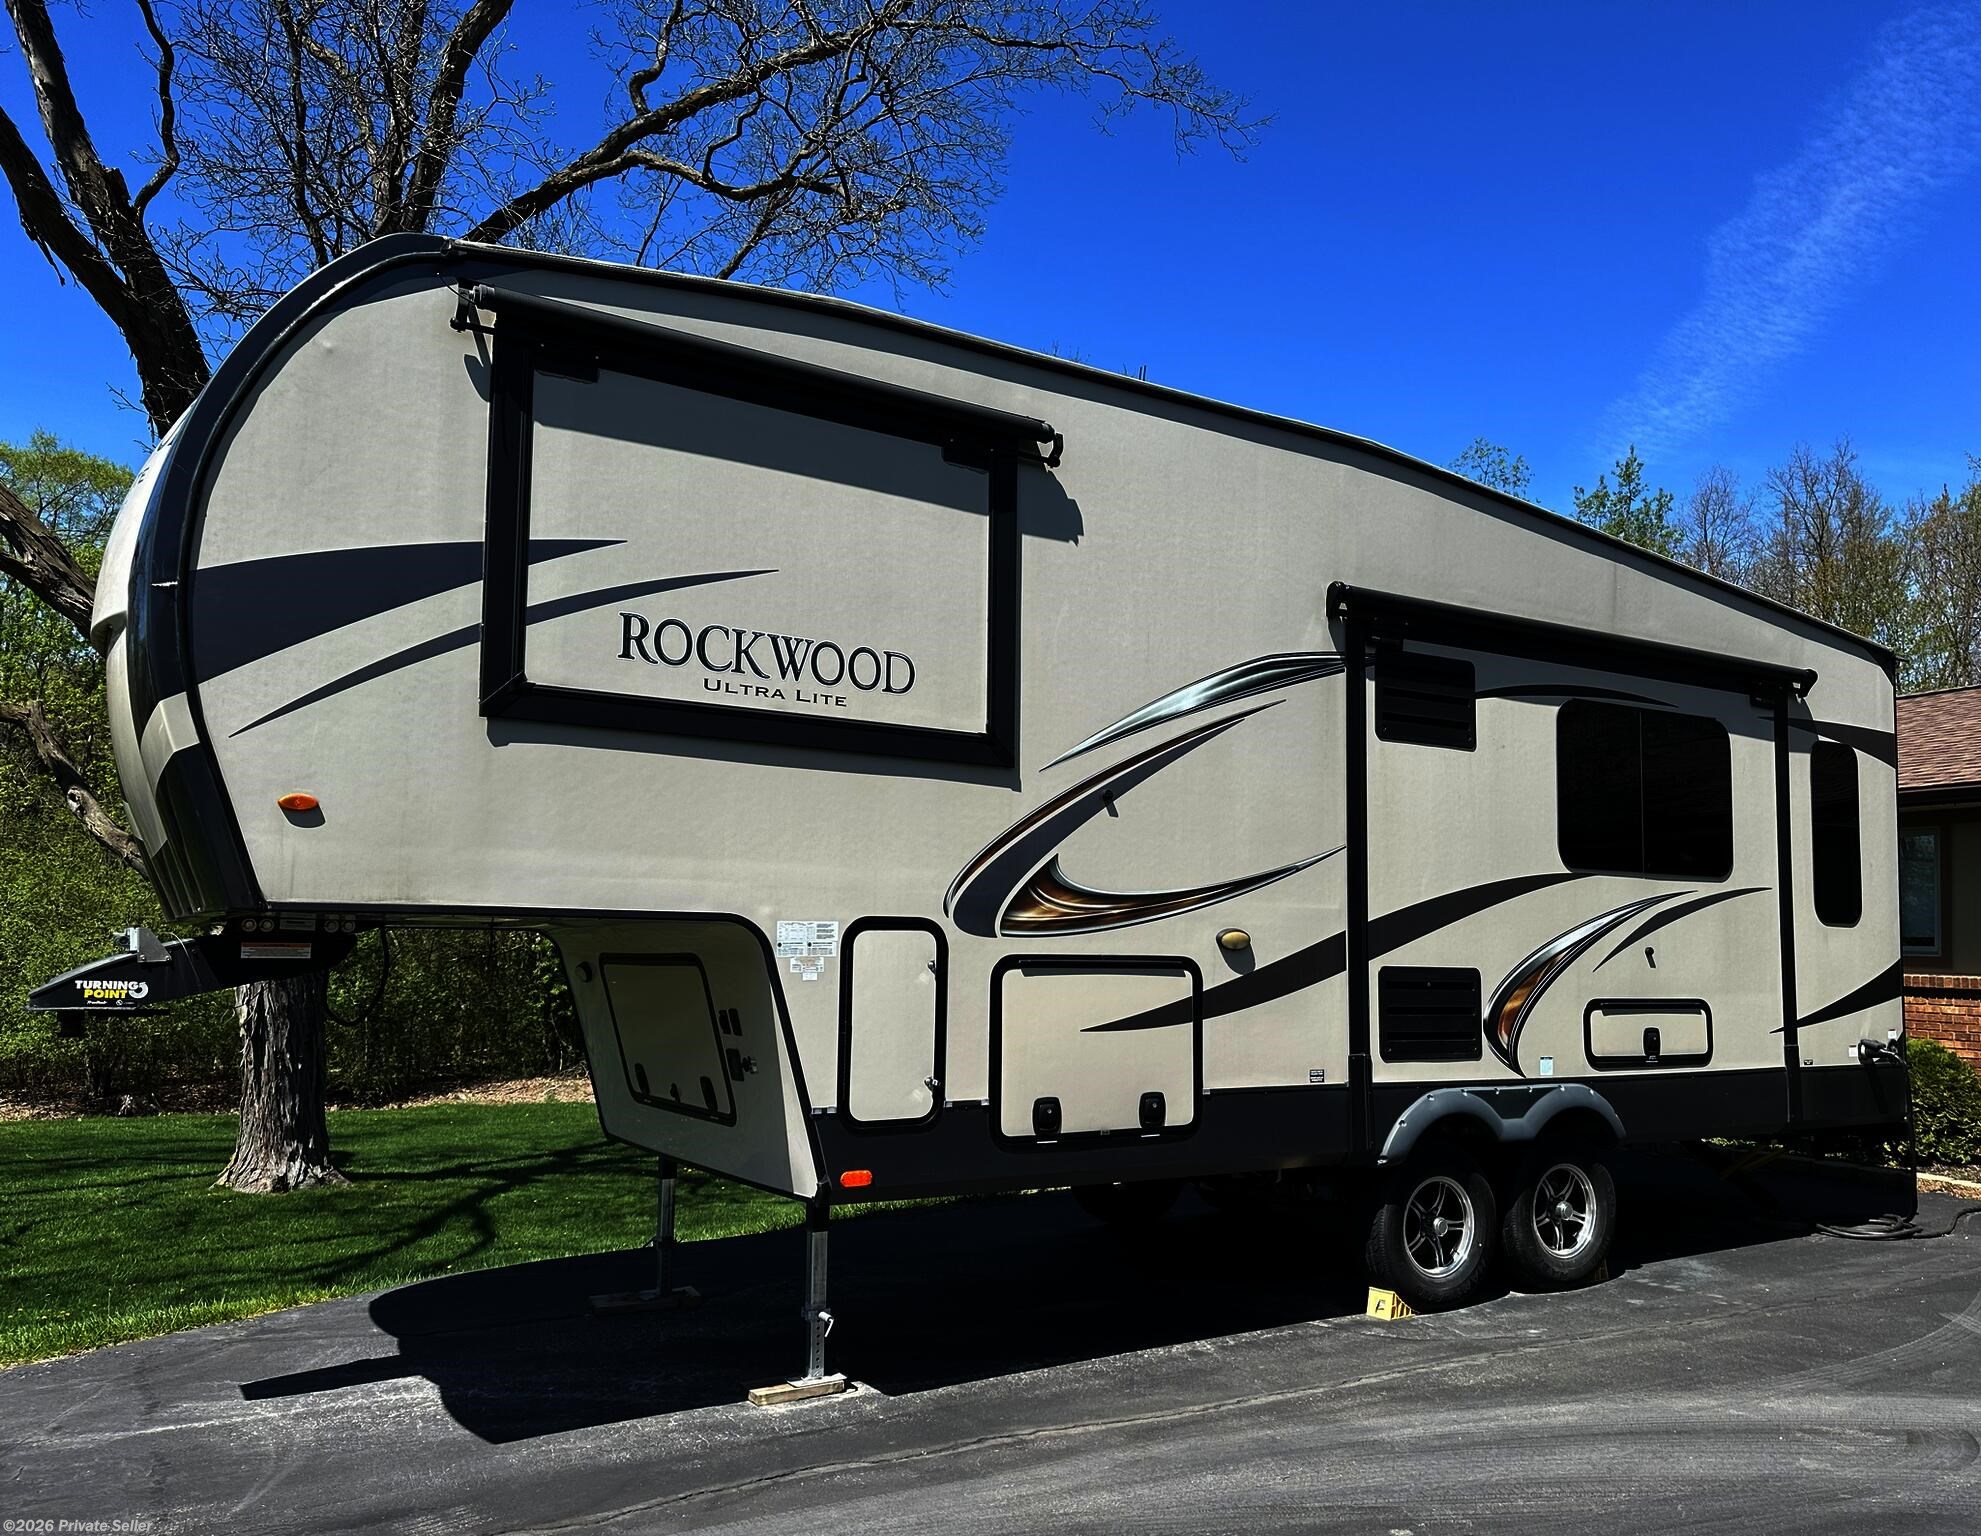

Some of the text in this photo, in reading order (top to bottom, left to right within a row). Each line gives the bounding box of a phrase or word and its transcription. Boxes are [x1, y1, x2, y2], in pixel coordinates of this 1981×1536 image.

[617, 611, 916, 694] ROCKWOOD
[74, 980, 139, 990] TURNING
[84, 989, 128, 999] POINT
